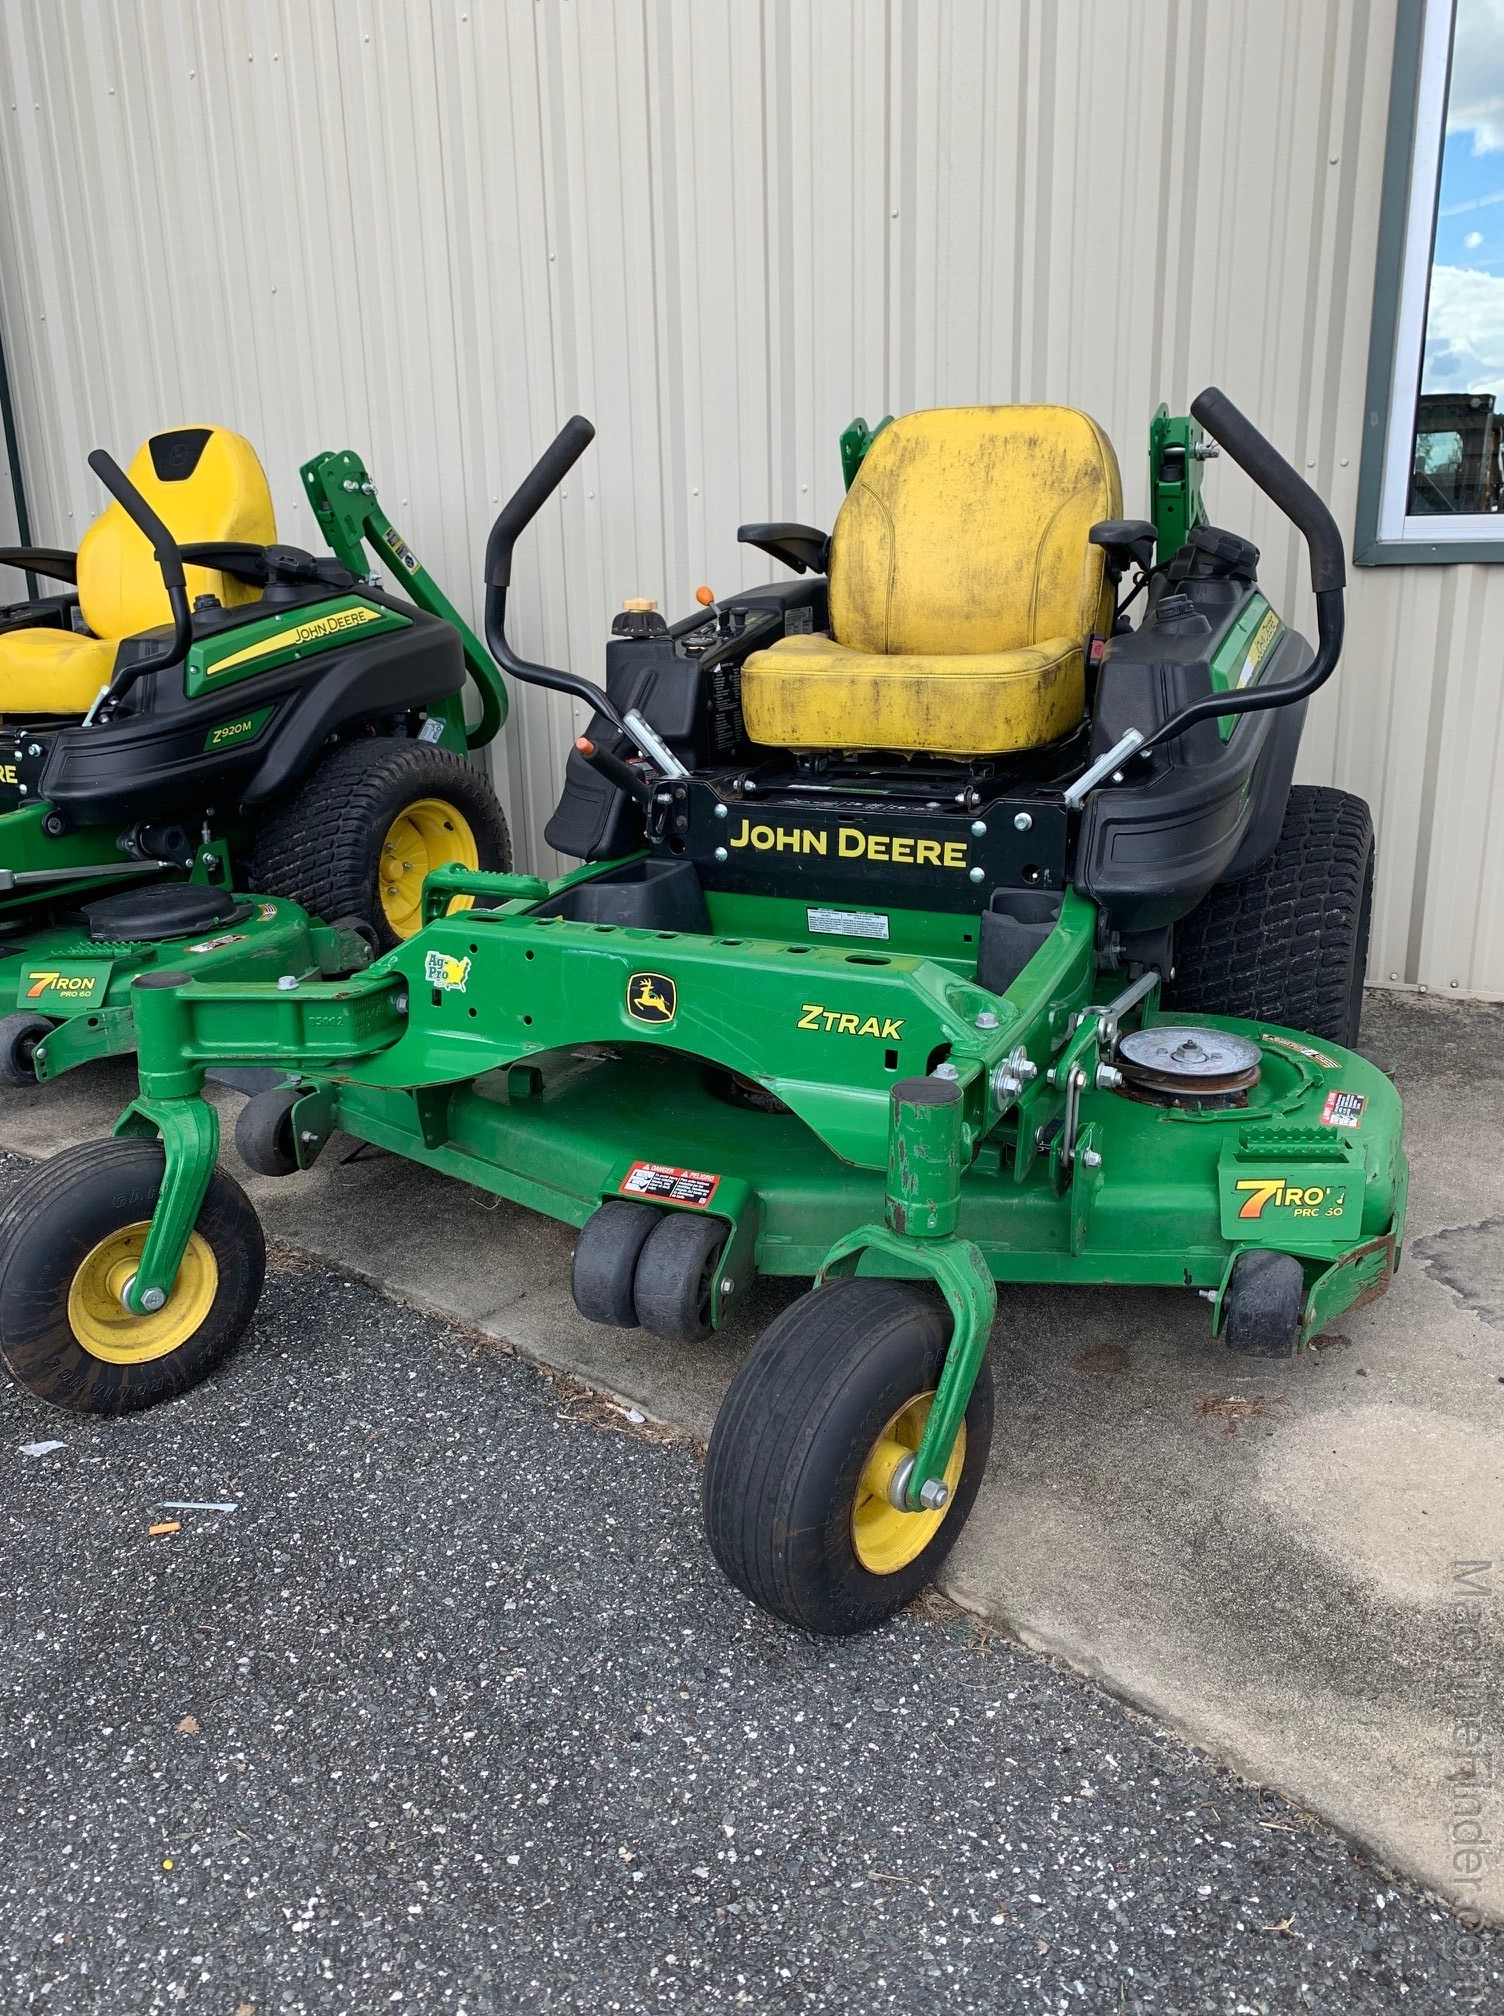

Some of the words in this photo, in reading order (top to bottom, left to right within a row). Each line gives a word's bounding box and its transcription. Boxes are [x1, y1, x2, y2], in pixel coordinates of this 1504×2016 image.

[295, 624, 327, 643] JOHN
[327, 611, 367, 631] DEERE
[212, 720, 252, 744] Z920M
[730, 819, 827, 855] JOHN
[838, 827, 968, 868] DEERE
[428, 966, 449, 980] Pro
[796, 1003, 908, 1041] ZTRAK
[651, 1165, 674, 1173] DANGER
[690, 1173, 714, 1181] PELIGRO
